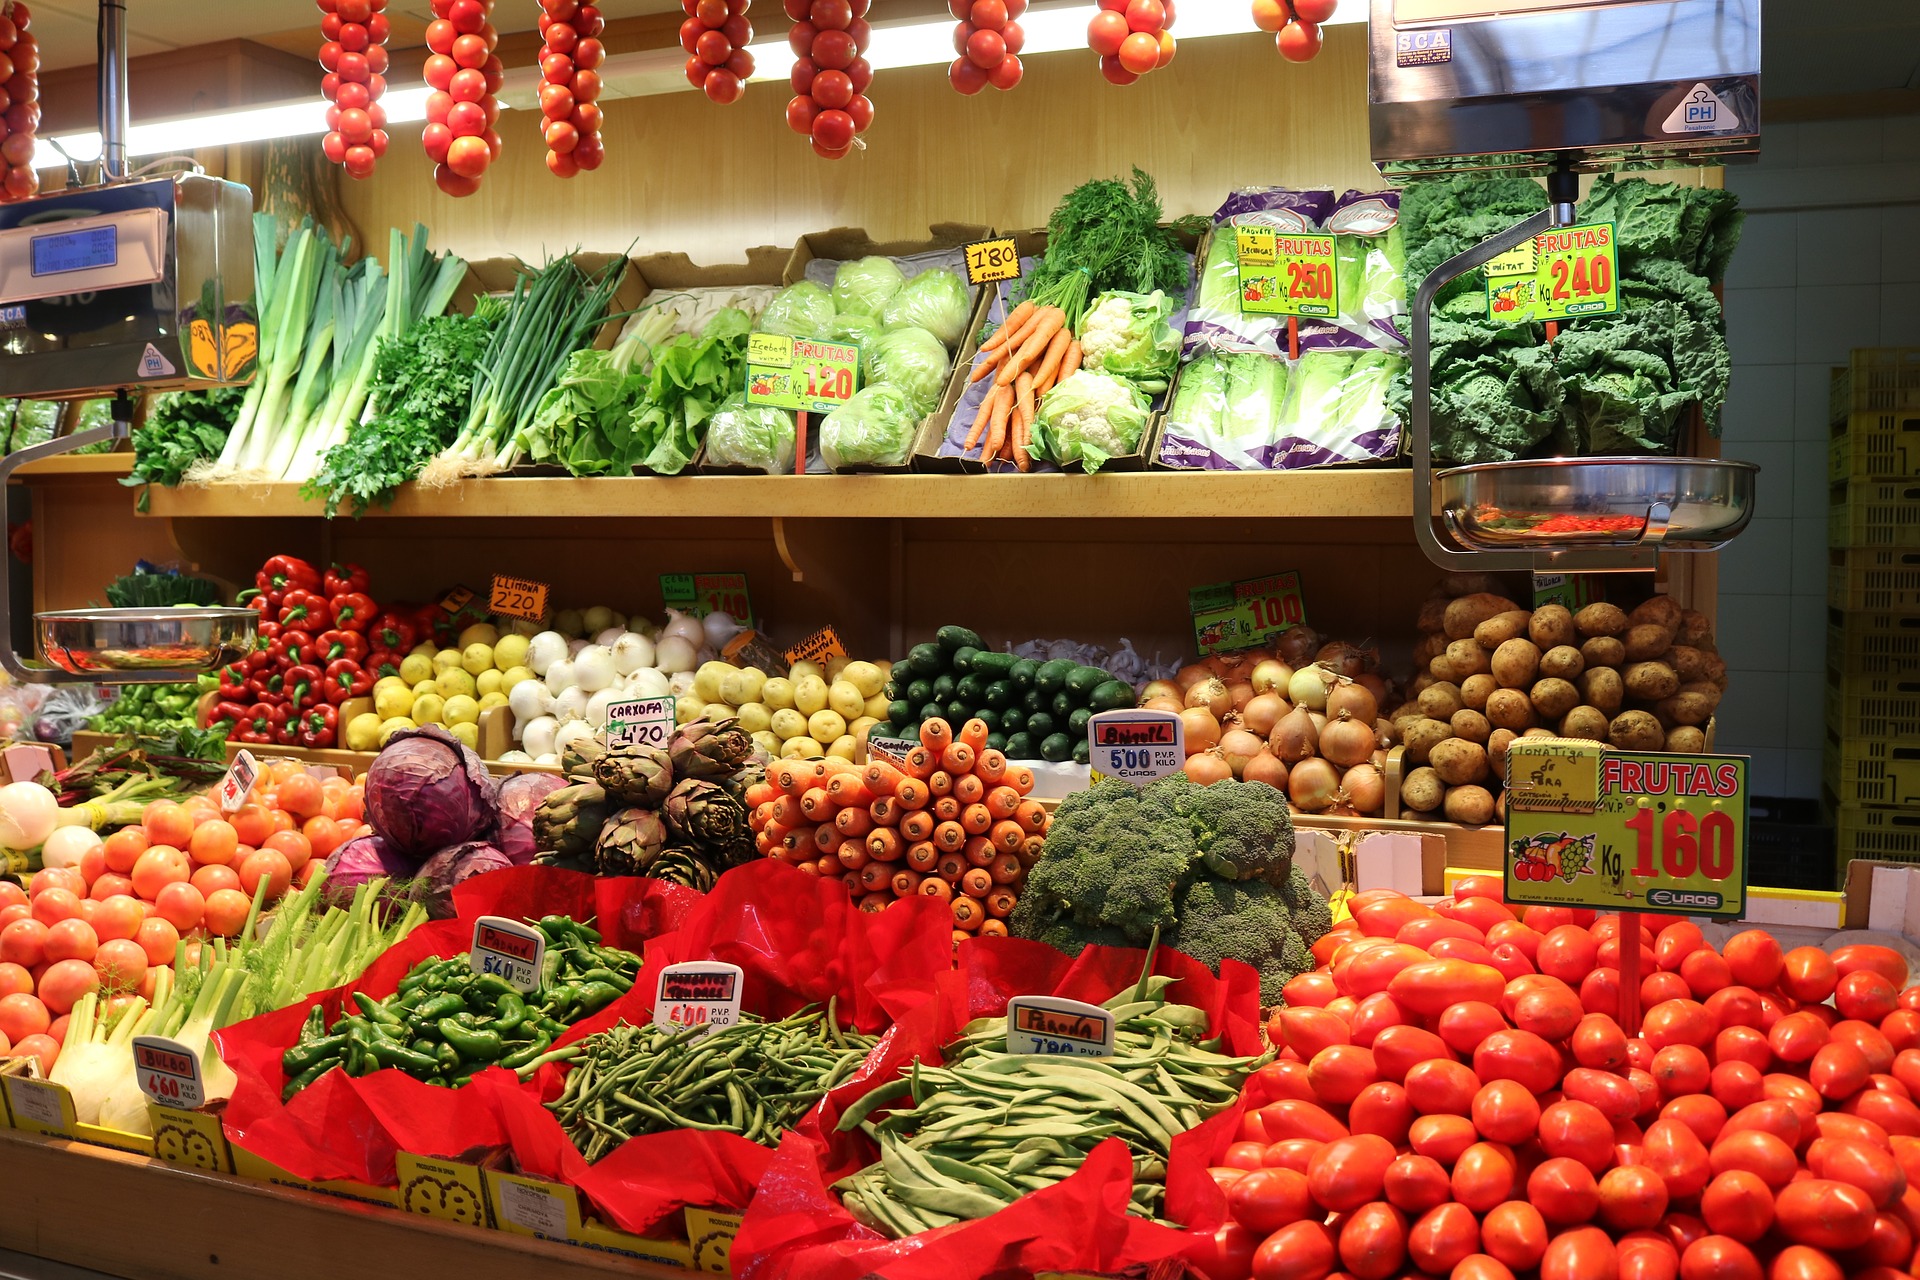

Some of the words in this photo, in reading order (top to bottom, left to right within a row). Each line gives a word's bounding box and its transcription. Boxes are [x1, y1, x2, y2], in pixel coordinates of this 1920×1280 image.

[1399, 32, 1449, 51] SCA
[1689, 106, 1711, 120] PH
[1242, 227, 1271, 235] PAQUETE
[1250, 236, 1258, 245] 2
[1276, 238, 1332, 256] FRUTAS
[1536, 227, 1610, 255] FRUTAS
[972, 247, 1014, 269] 1'80
[794, 341, 856, 363] FRUTAS
[147, 358, 160, 368] PH
[496, 578, 539, 594] LLIMONA
[695, 575, 745, 589] FRUTAS
[1234, 575, 1297, 599] FRUTAS
[494, 591, 535, 610] 2'20
[793, 634, 827, 657] PATATA
[610, 702, 662, 718] CARXOFA
[621, 725, 663, 744] 4'20
[1604, 759, 1738, 798] FRUTAS
[516, 975, 531, 985] KILO
[711, 1017, 729, 1025] KILO
[145, 1050, 187, 1073] BULBO
[182, 1091, 197, 1100] KILO
[416, 1162, 437, 1172] PRODUCED
[443, 1168, 455, 1176] SPAIN
[708, 1217, 734, 1228] PRODUCED
